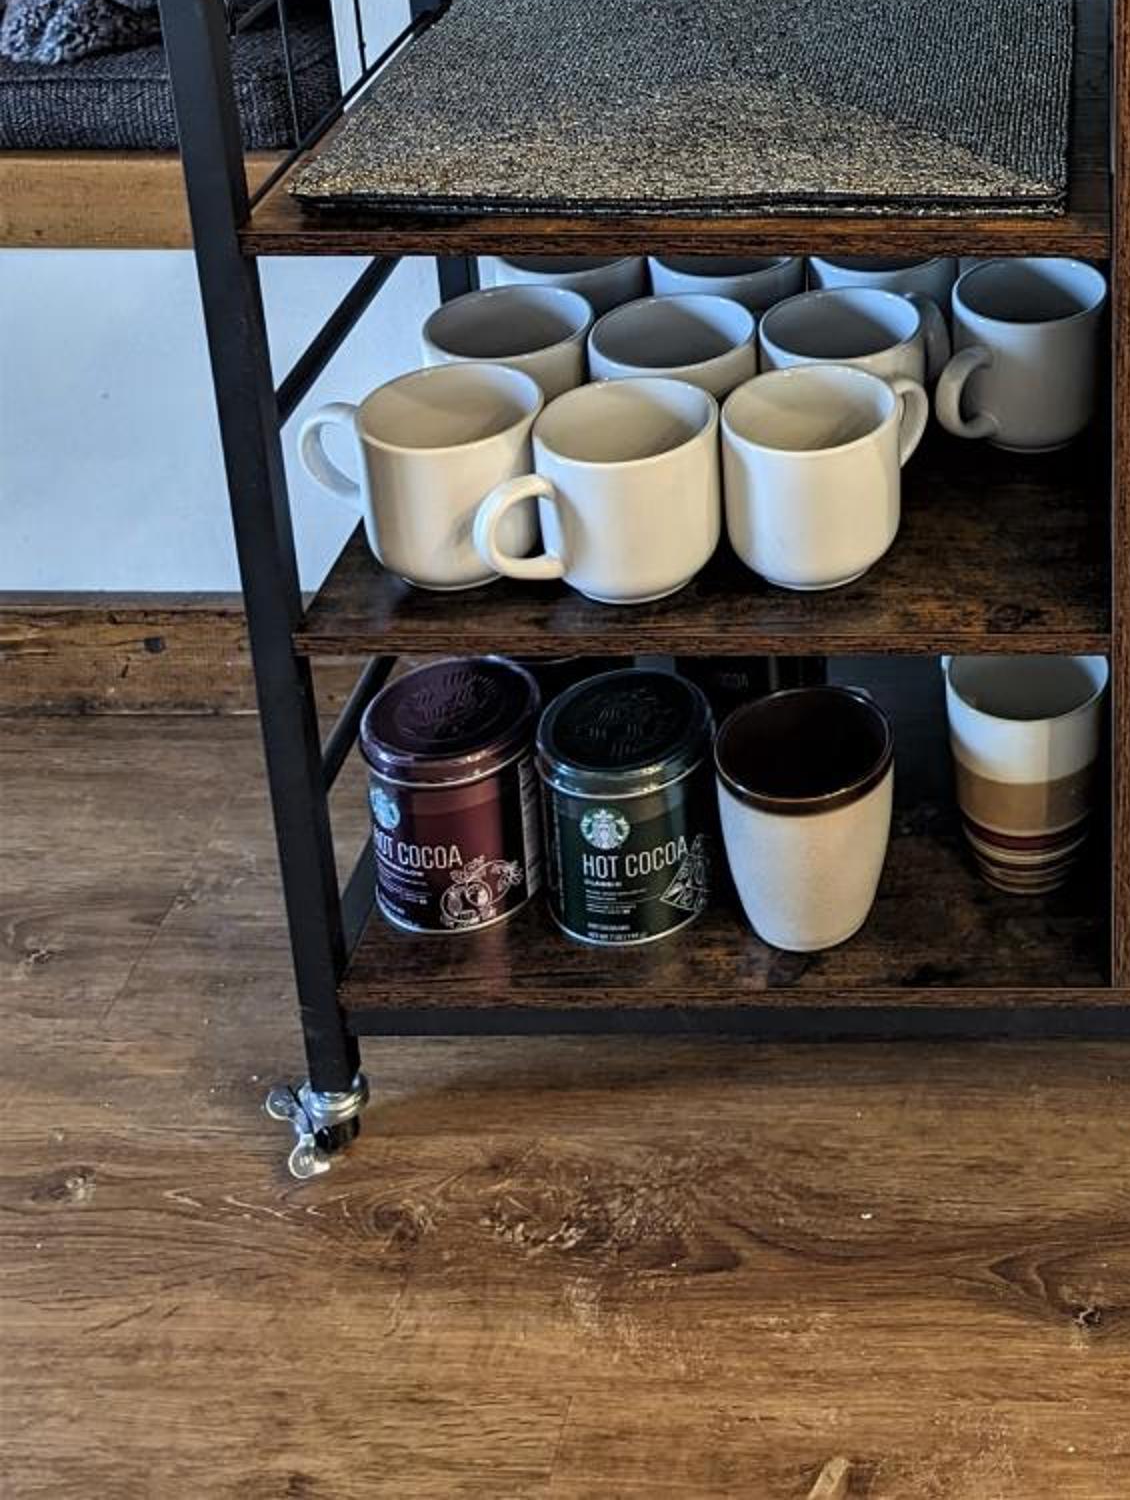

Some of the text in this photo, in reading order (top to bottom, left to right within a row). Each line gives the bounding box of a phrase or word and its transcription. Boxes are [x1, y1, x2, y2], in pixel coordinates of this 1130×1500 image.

[397, 841, 463, 869] COCOA
[582, 835, 689, 879] HOT COCOA
